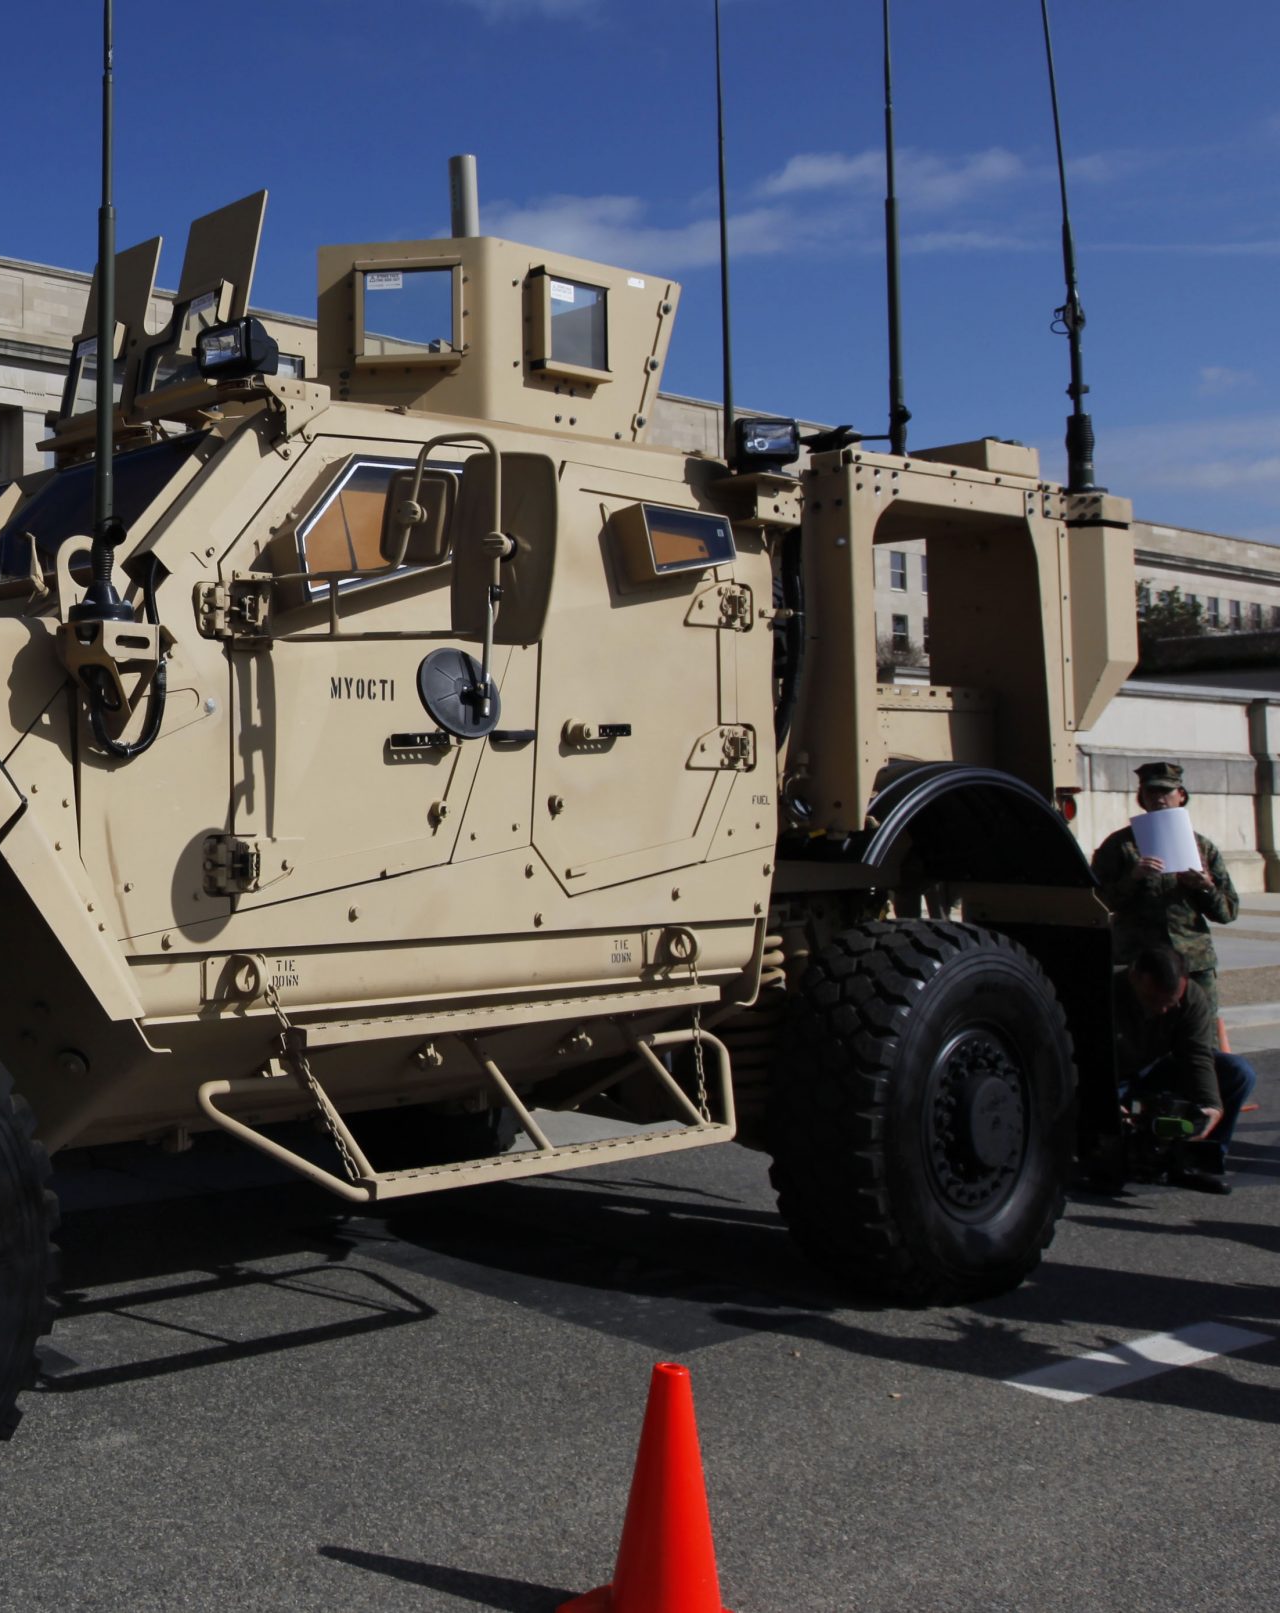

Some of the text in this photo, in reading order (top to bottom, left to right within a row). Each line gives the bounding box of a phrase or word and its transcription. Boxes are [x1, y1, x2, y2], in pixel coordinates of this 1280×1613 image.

[751, 794, 771, 806] FUEL
[613, 938, 629, 951] TIE
[611, 951, 632, 964] DOWN
[275, 959, 296, 972] TIE
[272, 974, 299, 988] DOWN
